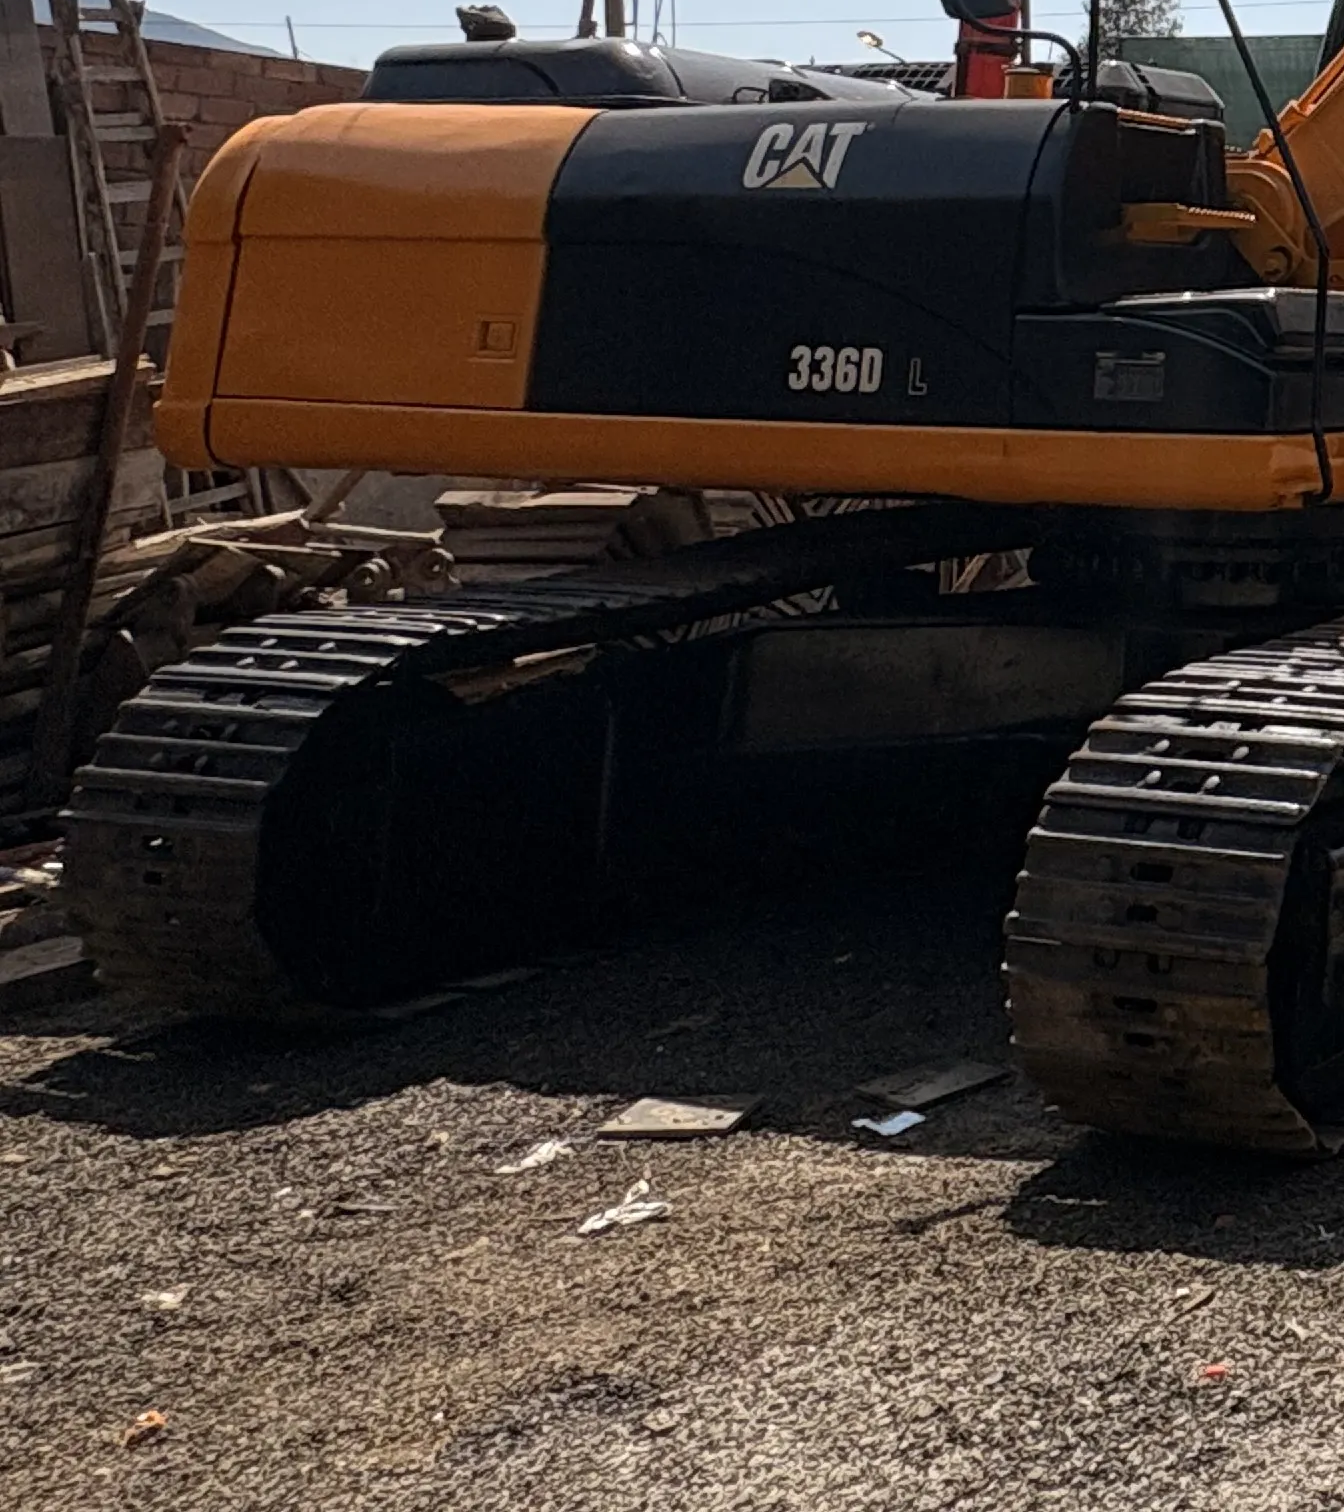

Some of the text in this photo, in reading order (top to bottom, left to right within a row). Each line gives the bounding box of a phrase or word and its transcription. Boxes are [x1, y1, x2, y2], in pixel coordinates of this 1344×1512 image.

[742, 121, 868, 189] CAT
[788, 344, 928, 396] 336D L
